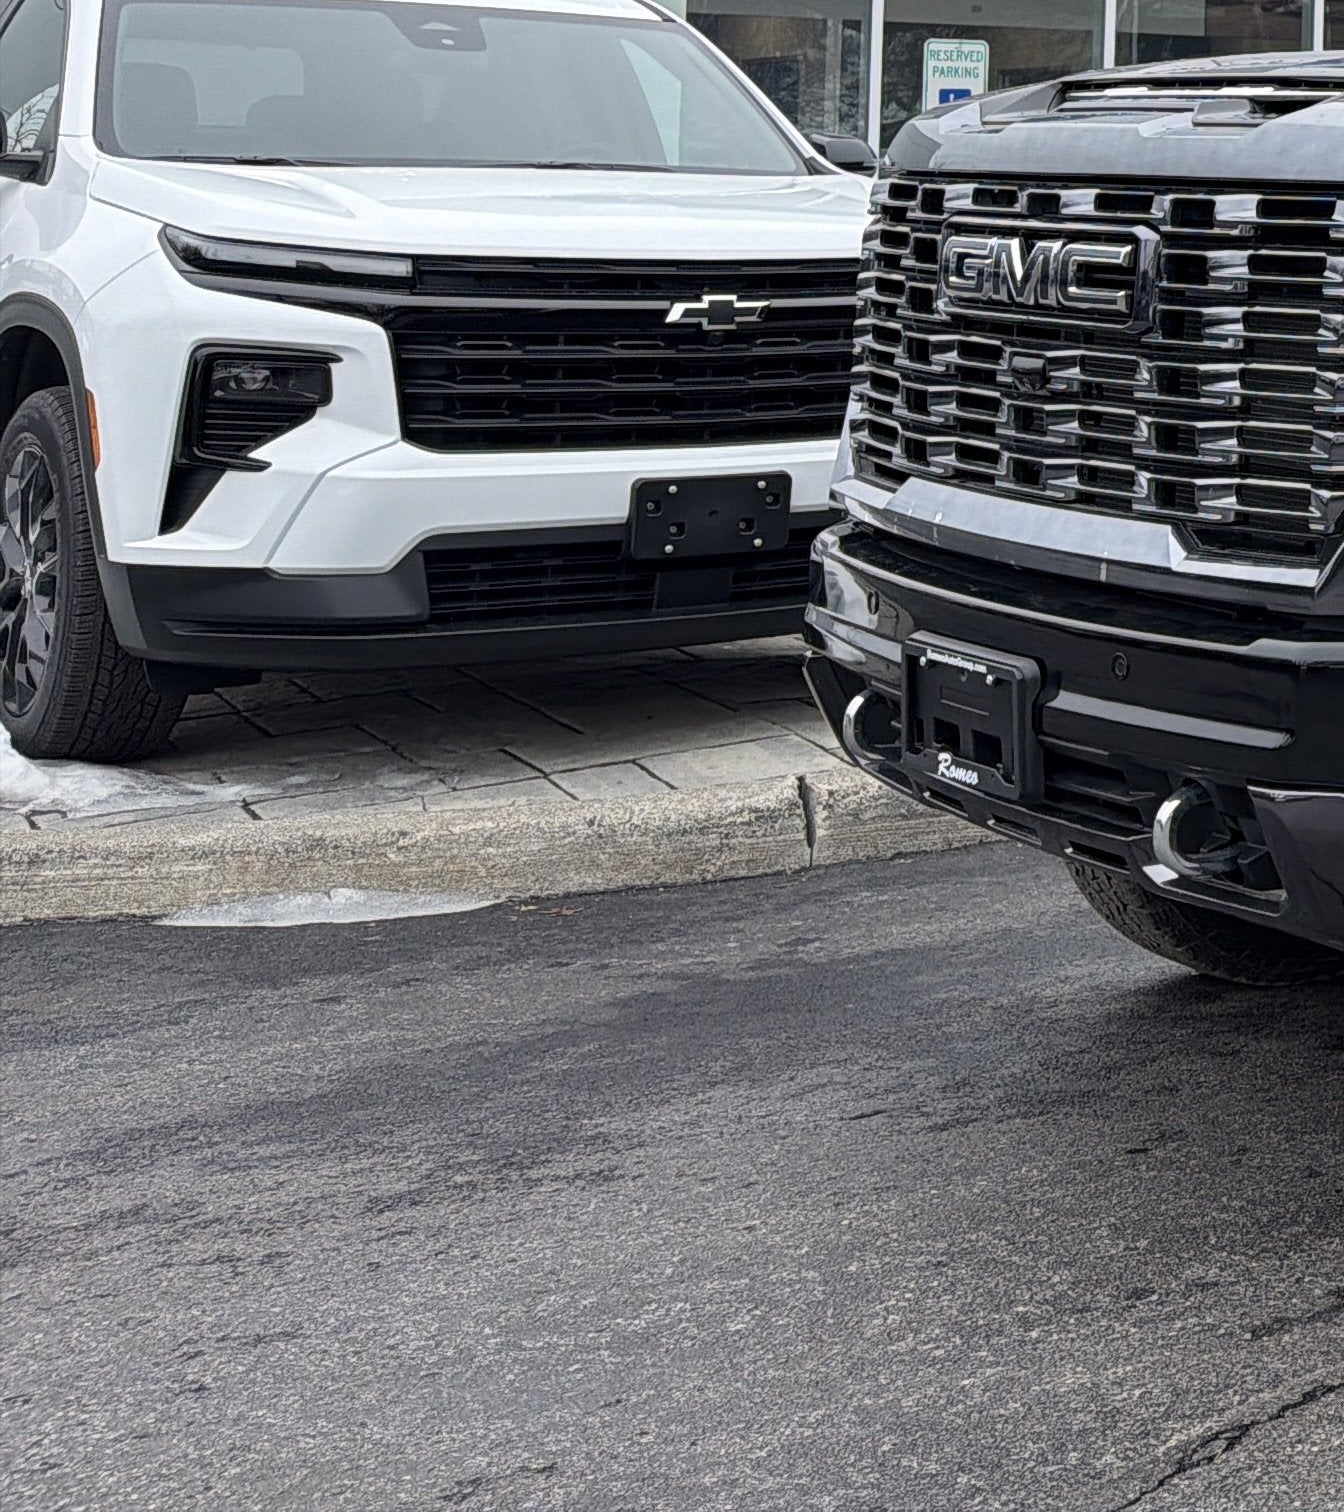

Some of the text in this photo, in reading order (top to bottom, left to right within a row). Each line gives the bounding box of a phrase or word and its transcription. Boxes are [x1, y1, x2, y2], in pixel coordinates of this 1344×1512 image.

[929, 49, 984, 63] RESERVED
[932, 65, 980, 79] PARKING
[941, 236, 1134, 313] GMC
[937, 752, 979, 786] Romeo
